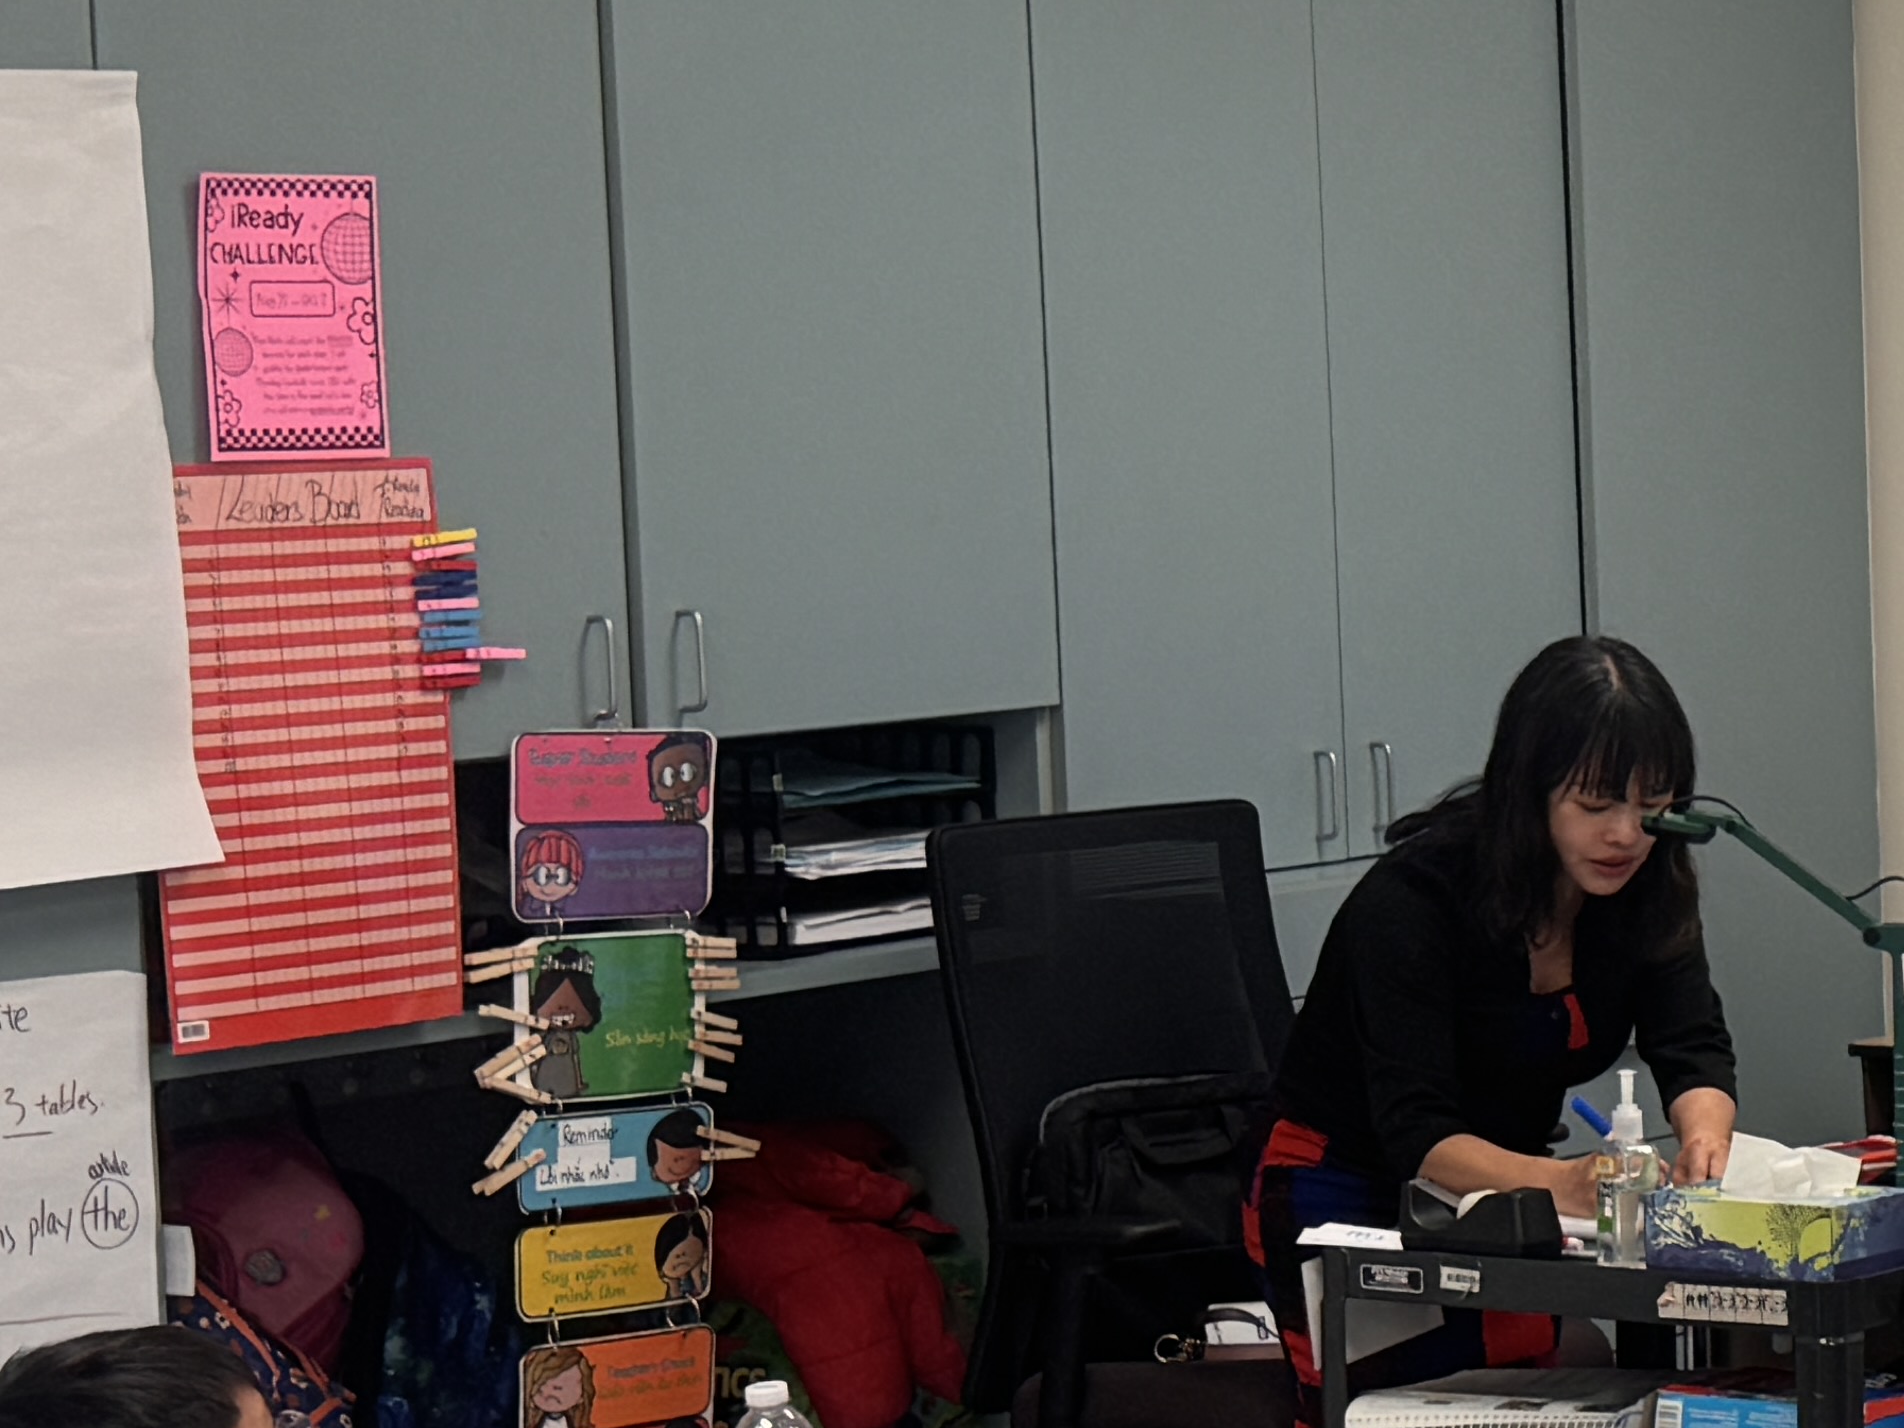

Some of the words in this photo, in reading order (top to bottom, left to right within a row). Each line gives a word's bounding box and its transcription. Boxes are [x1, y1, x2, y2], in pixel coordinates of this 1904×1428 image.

[230, 202, 304, 237] iReady
[209, 241, 319, 265] CHALLENGE
[4, 1087, 26, 1125] 3
[29, 1198, 72, 1255] play
[83, 1185, 130, 1232] the
[546, 1249, 582, 1264] Think
[585, 1246, 622, 1261] about
[625, 1244, 634, 1257] it
